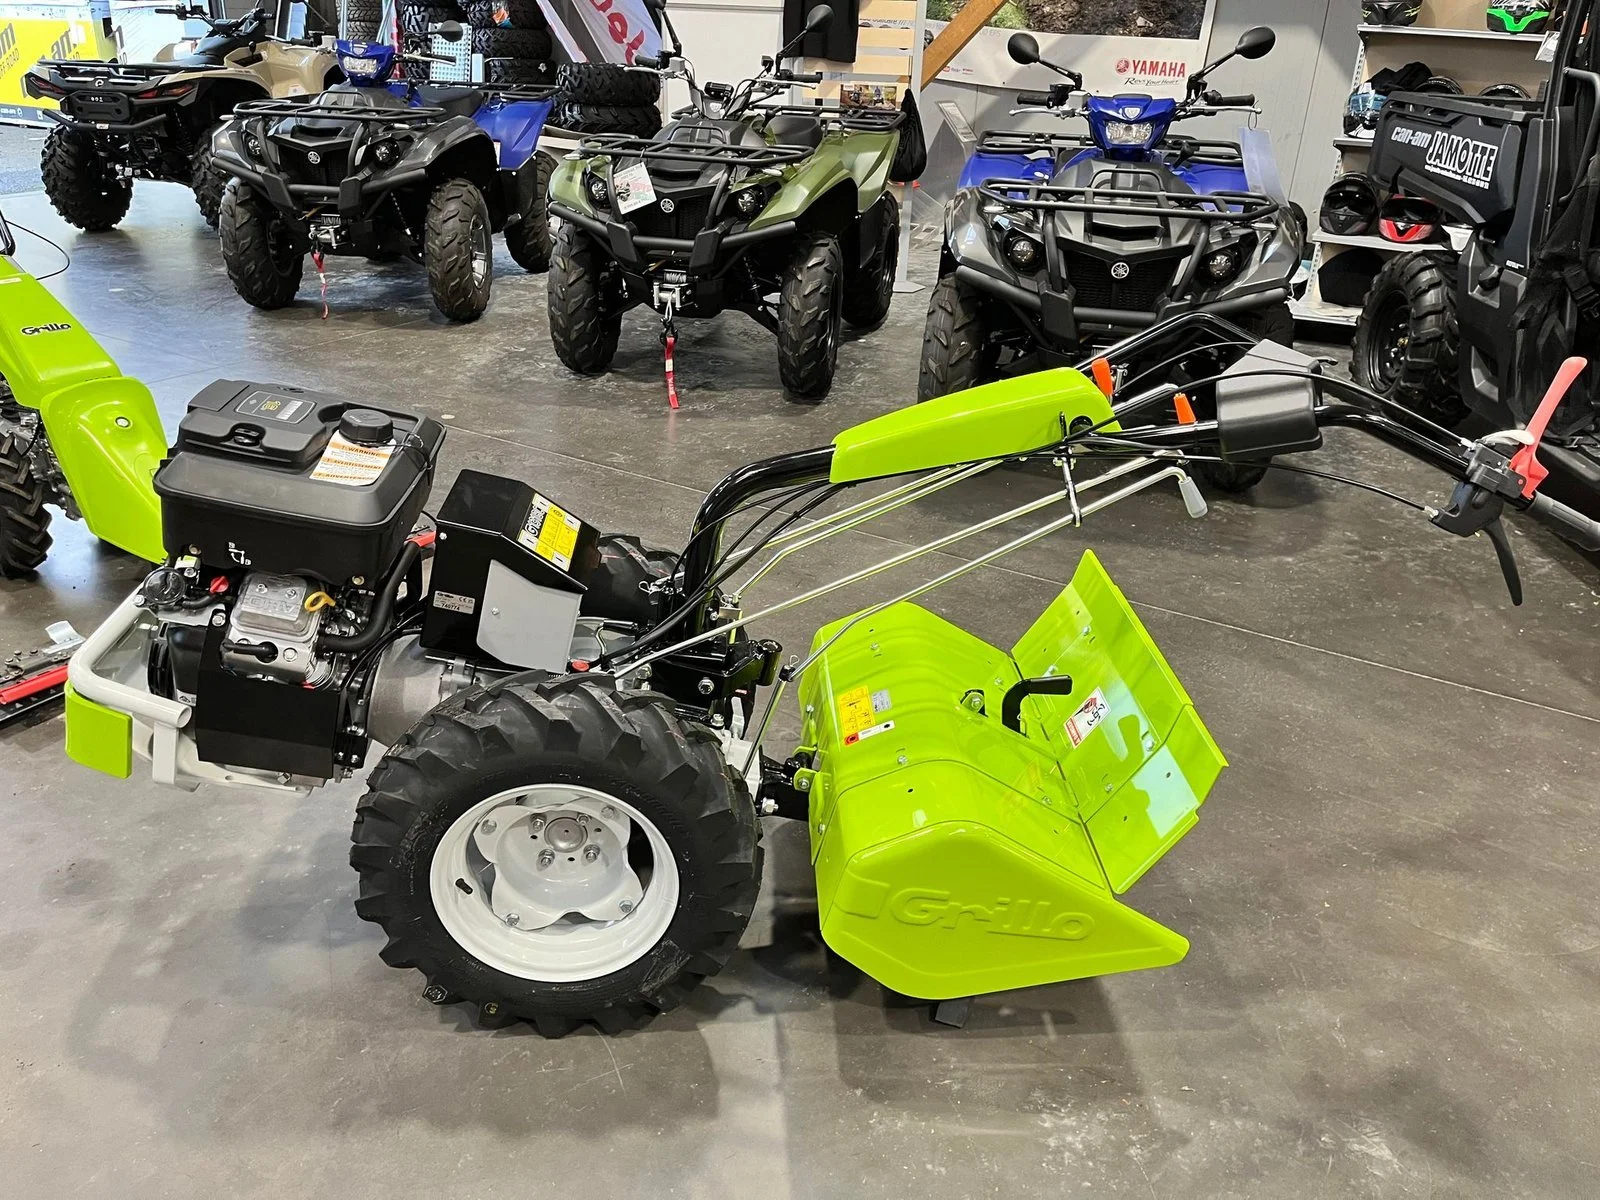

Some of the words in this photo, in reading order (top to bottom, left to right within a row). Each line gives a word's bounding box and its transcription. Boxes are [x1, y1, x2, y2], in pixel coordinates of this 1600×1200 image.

[1132, 59, 1186, 78] YAMAHA
[1391, 127, 1432, 149] can-am
[1426, 131, 1499, 181] JAMOTTE
[21, 323, 72, 336] Grillo
[348, 447, 381, 456] WARNING
[889, 887, 1095, 940] Grillo
